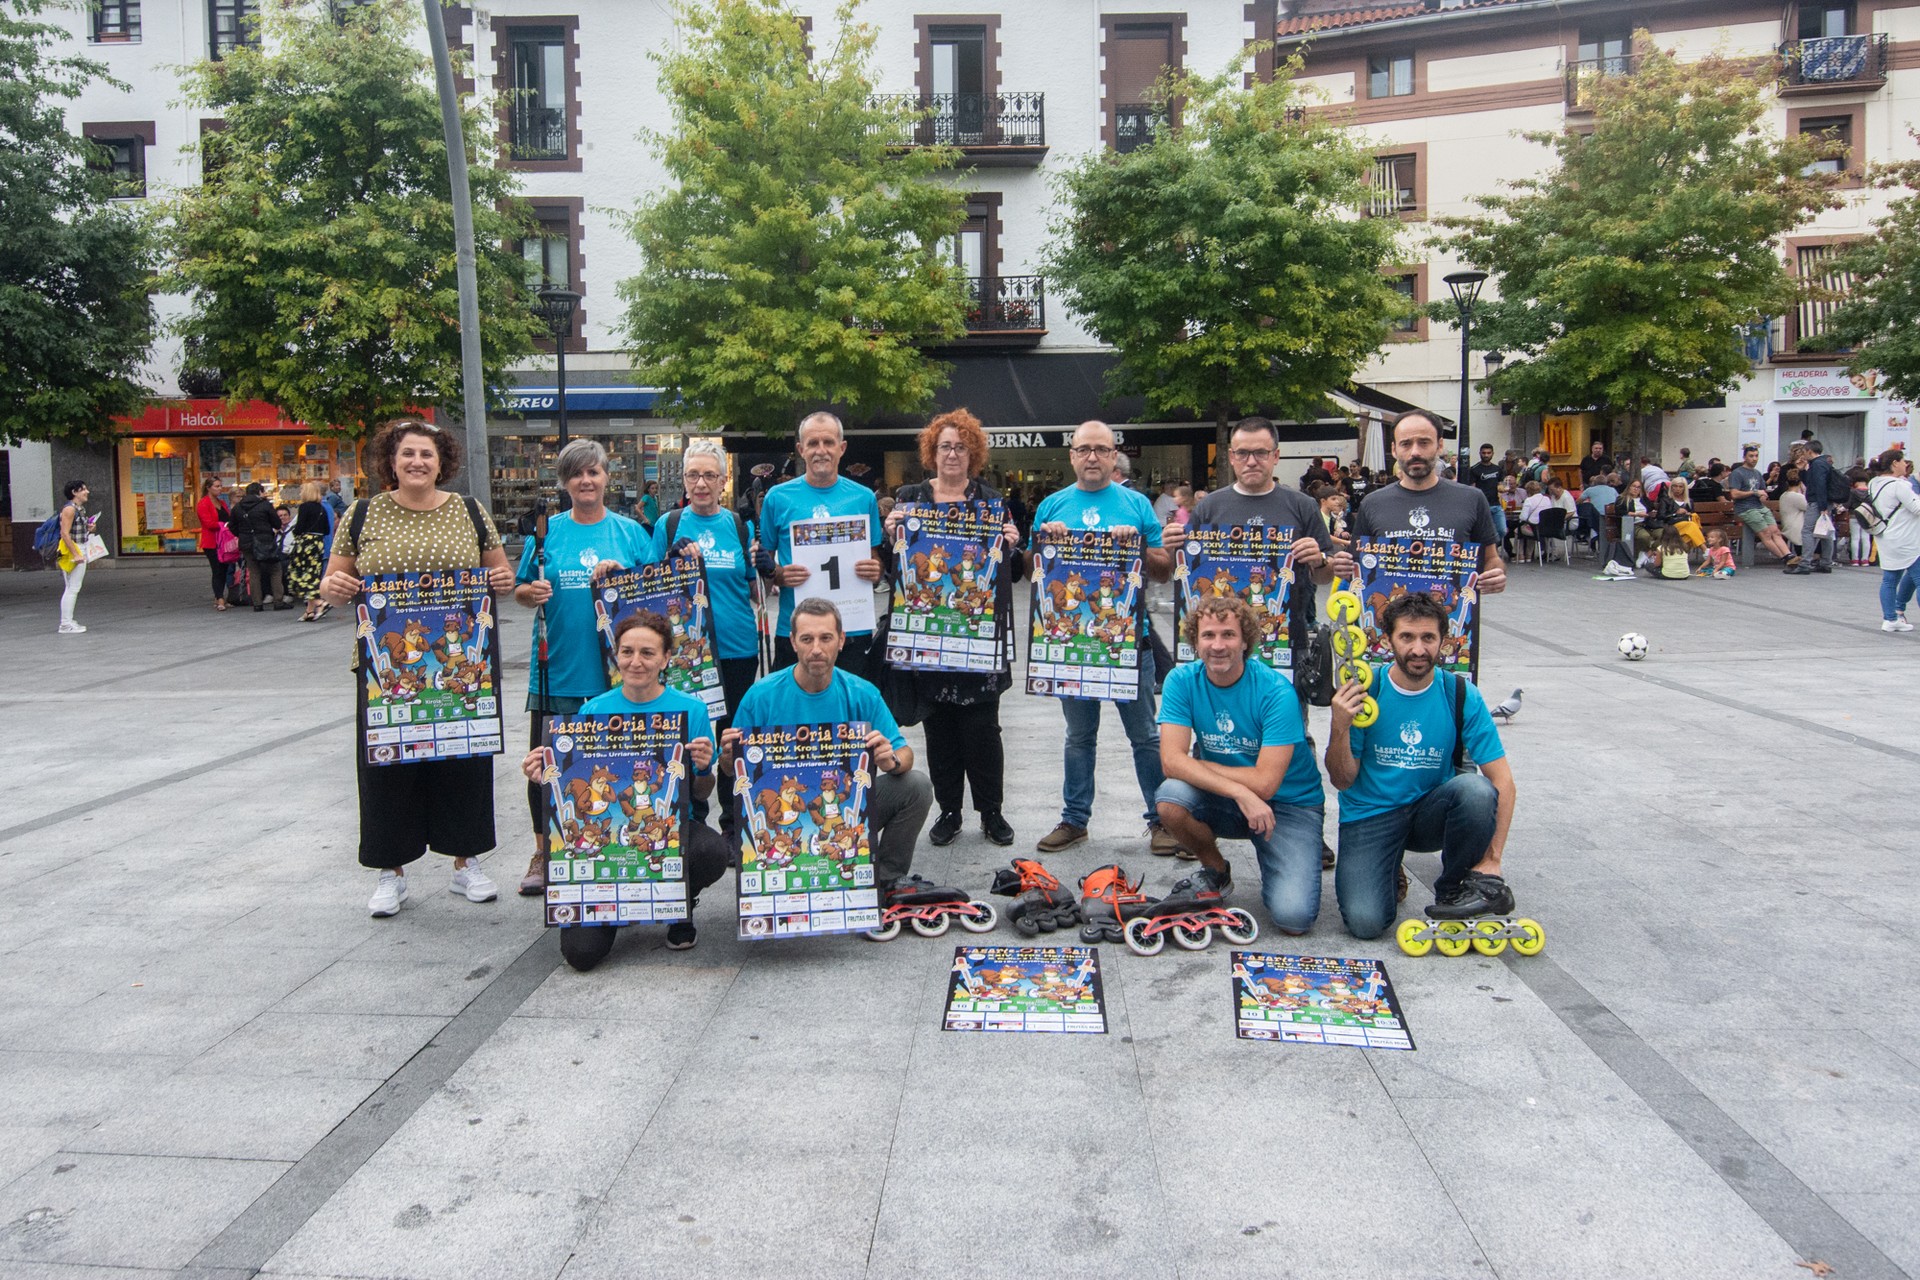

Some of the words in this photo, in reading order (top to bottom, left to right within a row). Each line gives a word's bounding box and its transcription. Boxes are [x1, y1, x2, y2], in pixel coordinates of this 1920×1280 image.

[1782, 370, 1828, 378] HELADERIA
[1792, 385, 1850, 396] sabores
[1062, 431, 1124, 446] KB
[1185, 527, 1262, 542] asarte-Oria
[1266, 528, 1294, 543] Bai!
[1385, 528, 1435, 538] Lasarte-Oria
[1438, 527, 1455, 538] Bai!
[1117, 534, 1142, 549] ai!
[1356, 539, 1444, 558] Lasarte-Oria
[1449, 544, 1479, 561] Bai!
[1406, 557, 1429, 565] Kros
[1432, 559, 1477, 568] Herrikoia
[558, 568, 593, 578] Lasarte-O
[820, 556, 840, 590] 1
[361, 574, 455, 593] Lasarte-Oria
[460, 570, 488, 586] Bai!
[388, 592, 414, 600] XXIV.
[417, 590, 441, 598] Kros
[444, 587, 488, 596] Herrikoia
[421, 604, 450, 612] Urriaren
[1181, 648, 1190, 656] 10
[1274, 653, 1290, 661] 10:30
[478, 702, 494, 710] 10:30
[372, 712, 383, 720] 10
[549, 716, 646, 734] Lasarte-Oria
[651, 714, 682, 732] Bai!
[575, 735, 602, 743] XXIV.
[606, 734, 630, 742] Kros
[634, 733, 681, 741] Herrikoia
[738, 727, 833, 746] Lasarte-Oria
[837, 724, 866, 741] Bai!
[765, 746, 791, 754] XXIV.
[821, 742, 866, 751] Herrikoia
[1374, 744, 1426, 756] Lasarte-Oria
[1428, 747, 1444, 758] Bai!
[554, 867, 564, 876] 10
[581, 866, 586, 874] 5
[664, 863, 681, 872] 10:30
[773, 876, 778, 885] 5
[854, 871, 872, 880] 10:30
[746, 878, 756, 887] 10
[866, 914, 878, 922] RUIZ
